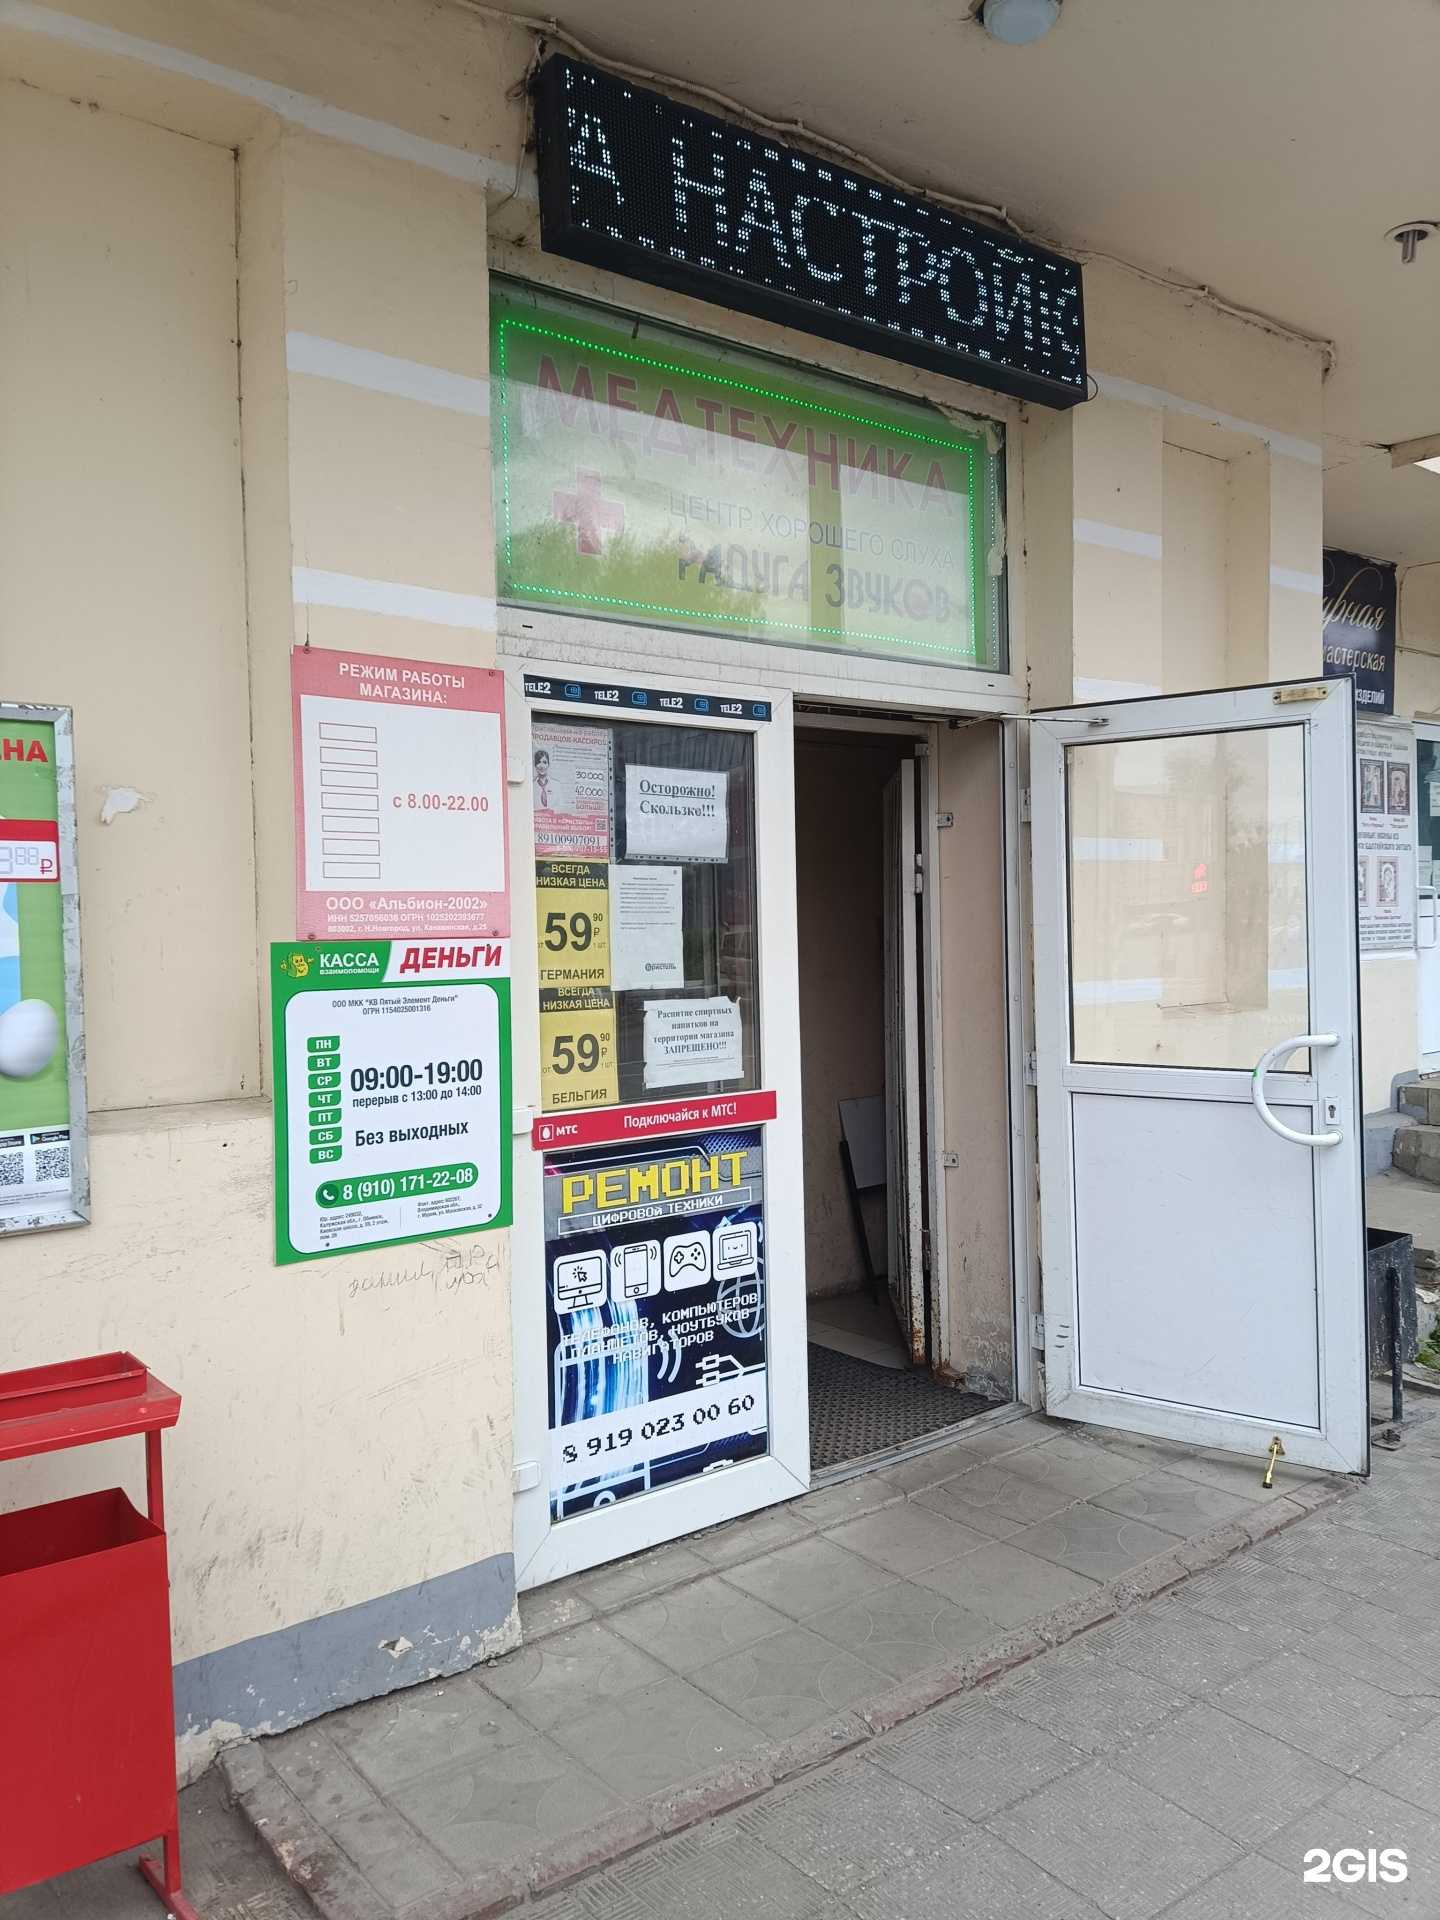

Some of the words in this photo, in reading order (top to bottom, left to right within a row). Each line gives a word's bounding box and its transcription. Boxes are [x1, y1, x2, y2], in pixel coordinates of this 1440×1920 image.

[671, 136, 1081, 357] НАСТРОЙК
[534, 354, 953, 513] МЕДТЕХНИКА
[669, 490, 753, 527] ЦЕНТР
[761, 512, 885, 556] ХОРОШЕГО
[891, 538, 953, 569] СЛУХА
[679, 536, 809, 601] РАДУГА
[824, 562, 952, 623] ЗВУКОВ
[338, 662, 398, 682] РЕЖИМ
[402, 670, 465, 690] РАБОТЫ
[359, 683, 448, 705] МАГАЗИНА:
[524, 682, 551, 694] TELE2
[594, 690, 619, 702] TELE2
[660, 697, 683, 709] TELE2
[720, 703, 742, 715] TELE2
[0, 738, 48, 763] НА
[639, 779, 716, 799] Осторожно!
[407, 793, 489, 813] 8.00-22.00
[639, 799, 716, 818] Скользко!!!
[536, 832, 600, 847] 89100907091
[551, 863, 591, 875] ВСЕГДА
[536, 876, 576, 888] НИЗКАЯ
[578, 876, 606, 888] ЦЕНА
[326, 896, 364, 911] ООО
[369, 896, 488, 911] «Альбион-2002»
[327, 913, 348, 923] ИНН
[401, 913, 424, 922] ОГРН
[592, 912, 604, 922] 90
[544, 912, 592, 952] 59
[319, 952, 380, 968] КАССА
[399, 945, 502, 974] ДЕНЬГИ
[540, 968, 605, 981] ГЕРМАНИЯ
[557, 987, 595, 998] ВСЕГДА
[332, 999, 347, 1008] ООО
[348, 999, 364, 1007] МКК
[380, 997, 401, 1006] Пятый
[402, 996, 431, 1005] Элемент
[543, 999, 583, 1010] НИЗКАЯ
[584, 997, 611, 1009] ЦЕНА
[362, 1006, 380, 1015] ОГРН
[657, 1009, 693, 1019] Распитие
[695, 1007, 733, 1018] спиртных
[672, 1021, 708, 1030] напитков
[710, 1020, 719, 1028] на
[315, 1039, 332, 1050] ПН
[600, 1032, 610, 1042] 90
[653, 1034, 699, 1044] территории
[700, 1031, 735, 1040] магазина
[552, 1033, 600, 1075] 59
[664, 1041, 727, 1055] ЗАПРЕЩЕНО!!!
[316, 1057, 332, 1068] ВТ
[316, 1075, 332, 1086] СР
[350, 1058, 483, 1093] 09:00-19:00
[317, 1093, 333, 1105] ЧТ
[352, 1092, 400, 1109] перерыв
[401, 1092, 408, 1103] с
[411, 1089, 438, 1101] 13:00
[440, 1089, 454, 1101] до
[456, 1084, 482, 1098] 14:00
[552, 1088, 608, 1104] БЕЛЬГИЯ
[318, 1112, 333, 1123] ПТ
[623, 1108, 700, 1129] Подключайся
[702, 1108, 709, 1119] к
[711, 1102, 737, 1116] МТС!
[317, 1129, 334, 1141] СБ
[355, 1127, 385, 1147] Без
[389, 1121, 469, 1143] выходных
[556, 1124, 578, 1136] МТС
[318, 1149, 334, 1161] ВС
[342, 1185, 353, 1199] 8
[357, 1180, 396, 1199] (910)
[400, 1167, 474, 1192] 171-22-08
[562, 1150, 749, 1214] РЕМОНТ
[666, 1194, 724, 1214] ТЕХНИКИ
[662, 1292, 759, 1325] КОМПЬЮТЕРОВ
[672, 1308, 750, 1336] НОУТБУКОВ
[613, 1330, 715, 1364] НАВИГАТОРОВ
[562, 1444, 578, 1464] 8
[586, 1429, 633, 1457] 919
[640, 1414, 686, 1440] 023
[692, 1403, 721, 1426] 00
[728, 1394, 756, 1417] 60
